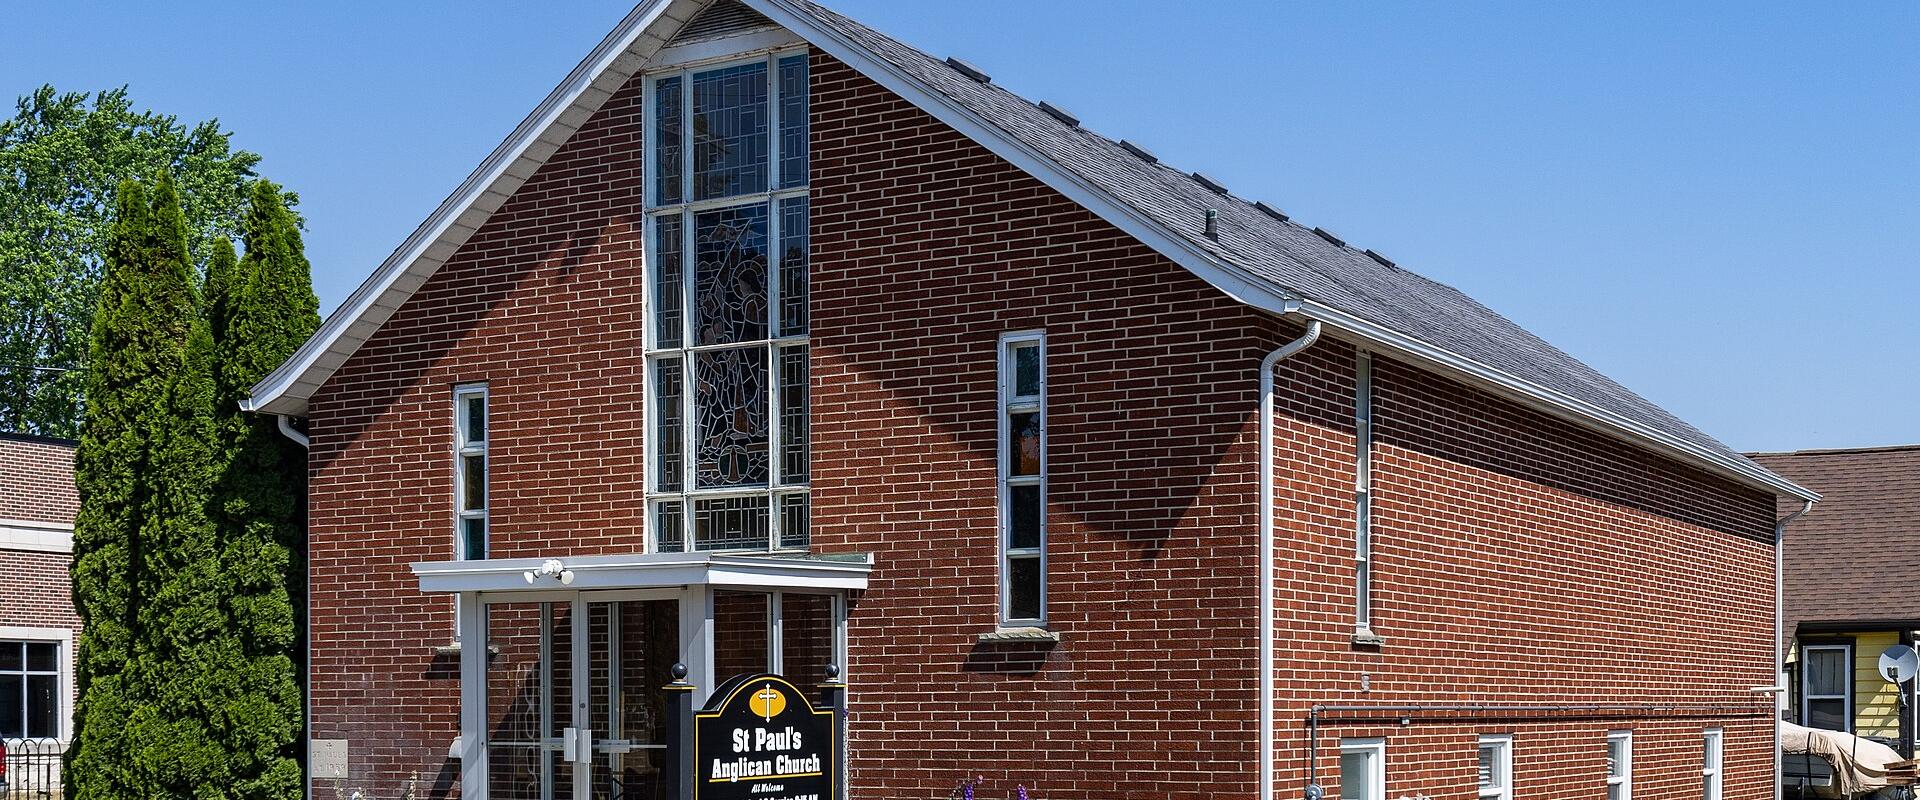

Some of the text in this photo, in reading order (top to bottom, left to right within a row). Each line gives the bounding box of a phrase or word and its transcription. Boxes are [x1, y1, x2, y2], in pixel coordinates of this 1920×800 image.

[732, 726, 802, 753] St Paul's
[711, 753, 821, 783] Anglican Church
[751, 783, 784, 794] All Welcome
